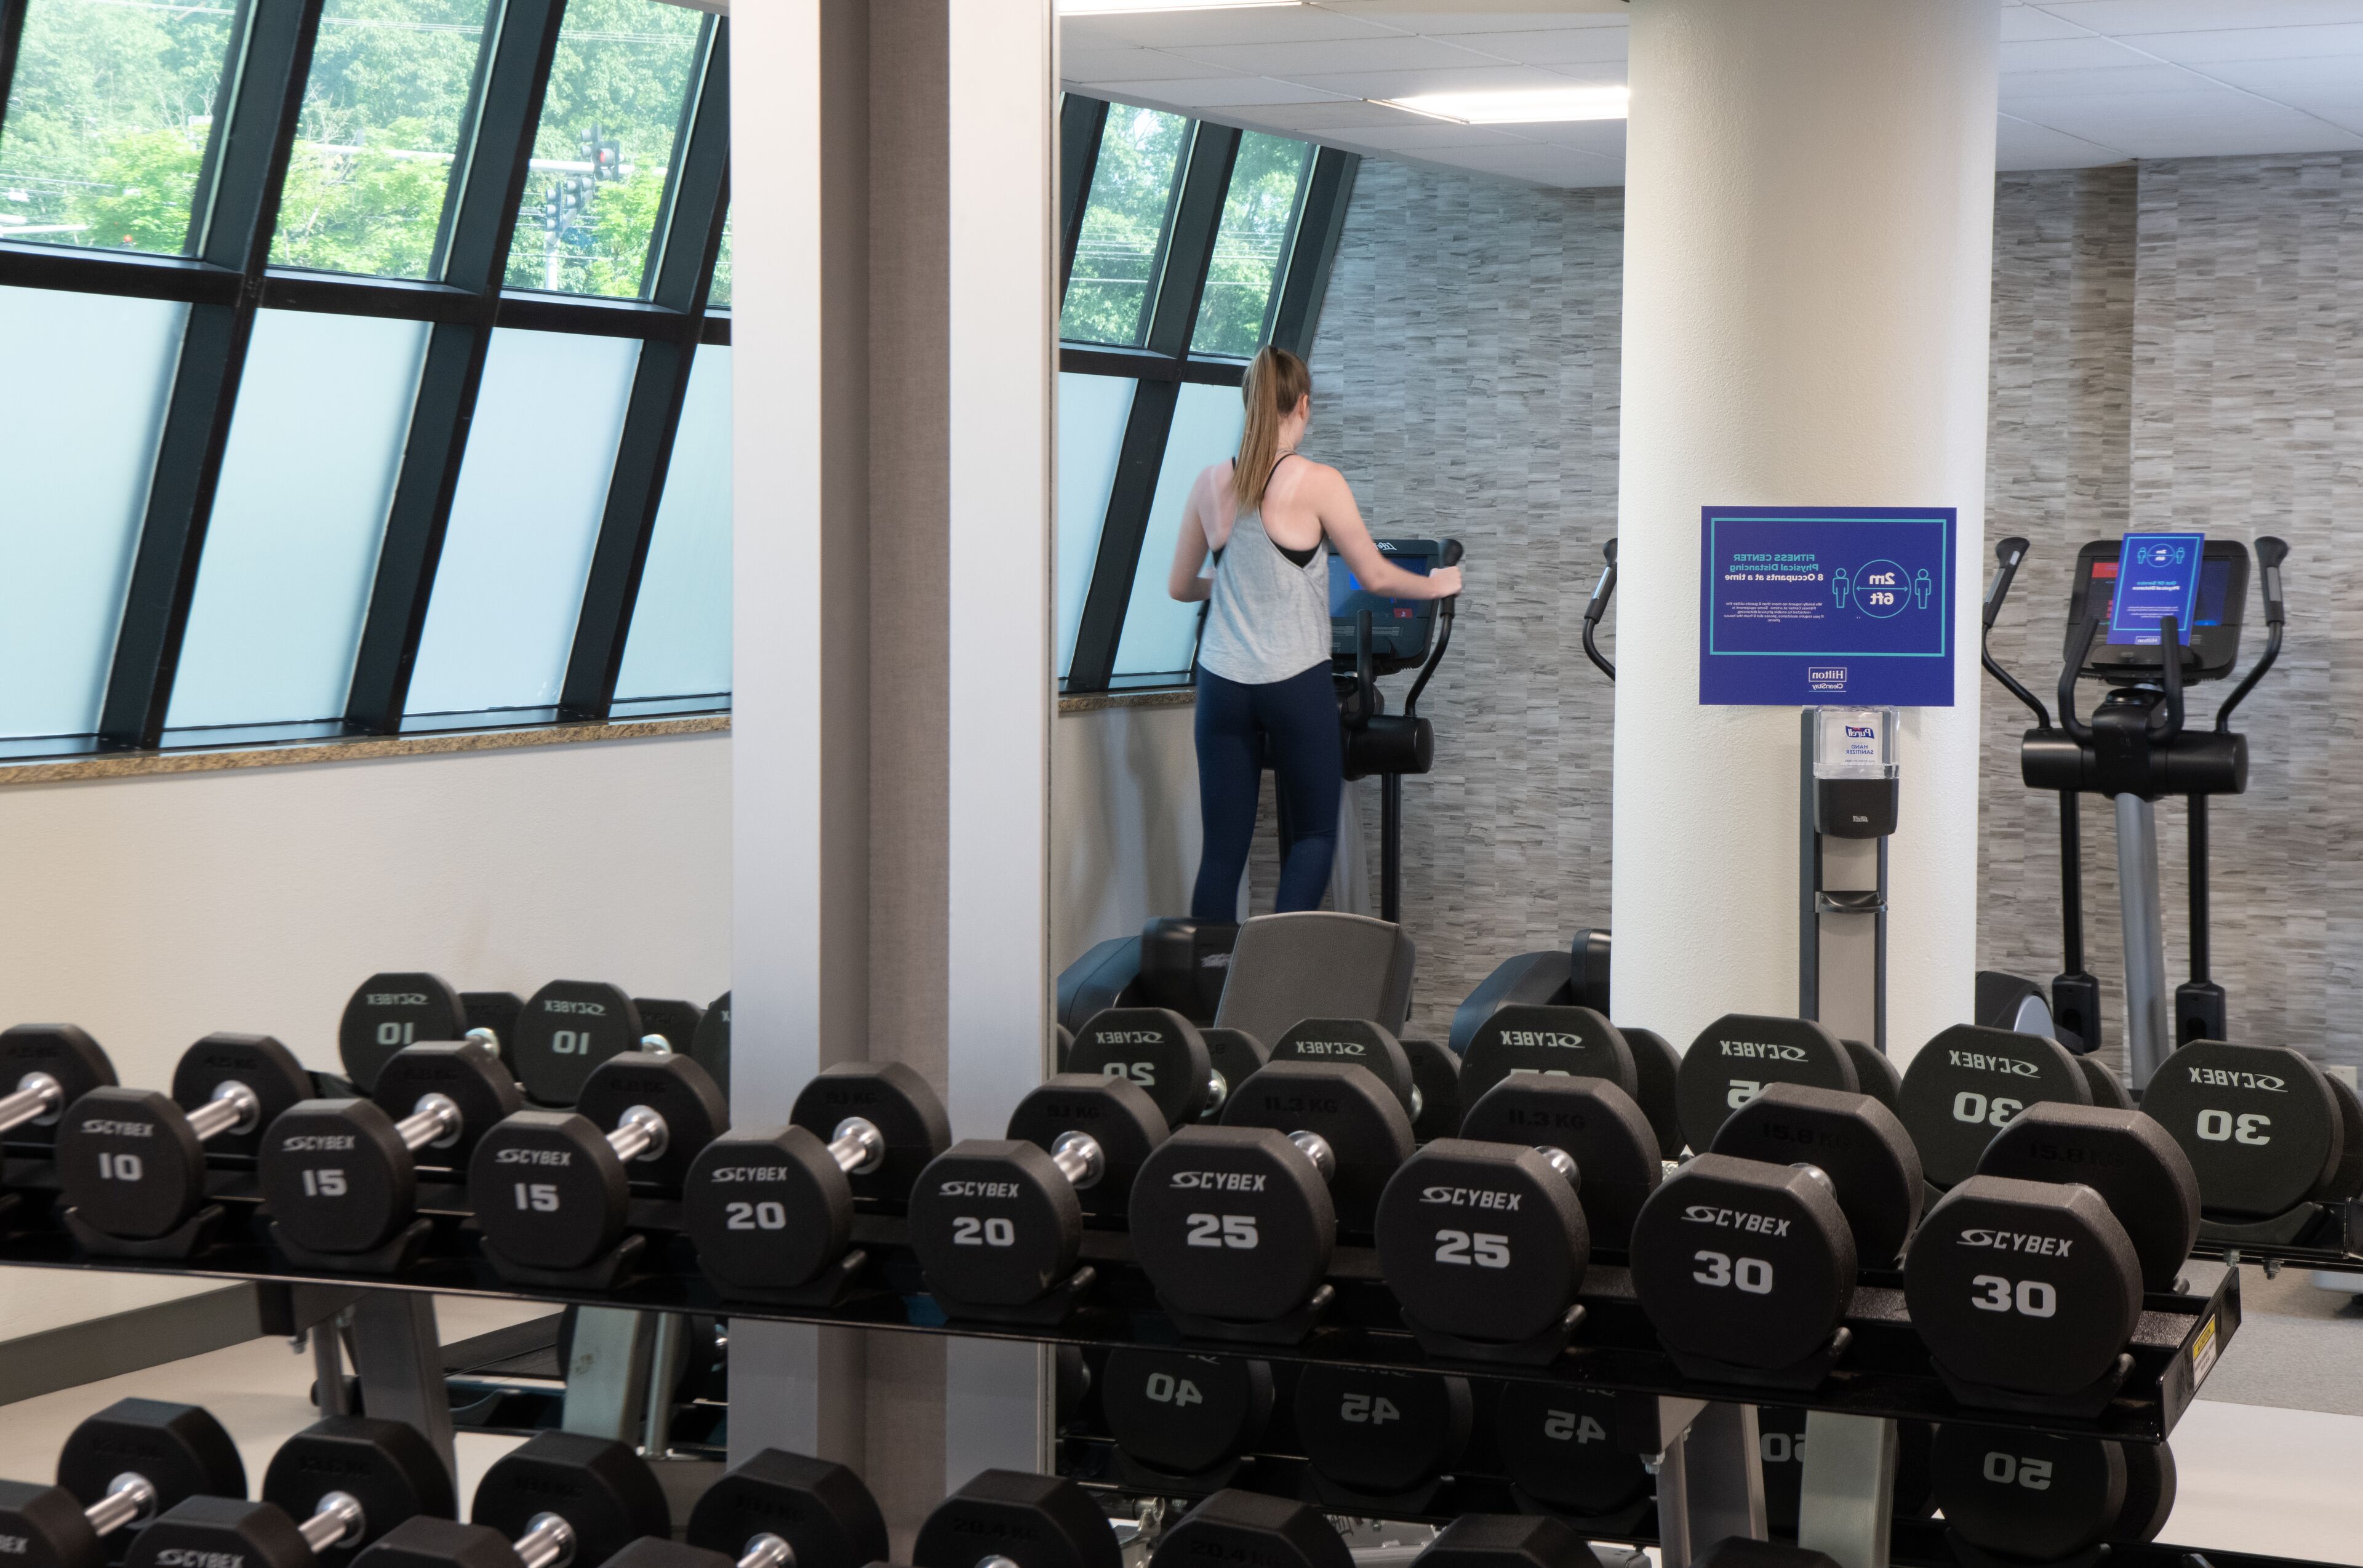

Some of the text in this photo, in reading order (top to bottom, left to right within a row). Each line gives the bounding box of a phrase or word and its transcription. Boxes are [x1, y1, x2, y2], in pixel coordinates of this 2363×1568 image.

[1309, 1098, 1338, 1113] KG
[103, 1121, 154, 1137] CYBEX
[1508, 1110, 1586, 1129] 11.3 KG
[304, 1135, 356, 1152] CYBEX
[98, 1152, 142, 1182] 10
[518, 1150, 572, 1166] CYBEX
[302, 1169, 347, 1197] 15
[734, 1166, 788, 1182] CYBEX
[1200, 1172, 1266, 1191] CYBEX
[514, 1182, 560, 1212] 15
[964, 1182, 1020, 1198] CYBEX
[1452, 1188, 1522, 1211] CYBEX
[726, 1201, 786, 1230] 20
[1716, 1208, 1791, 1237] CYBEX
[952, 1217, 1015, 1247] 20
[1186, 1213, 1259, 1249] 25
[1993, 1231, 2073, 1258] CYBEX
[1435, 1229, 1510, 1269] 25
[1693, 1250, 1773, 1295] 30
[1972, 1274, 2057, 1318] 30
